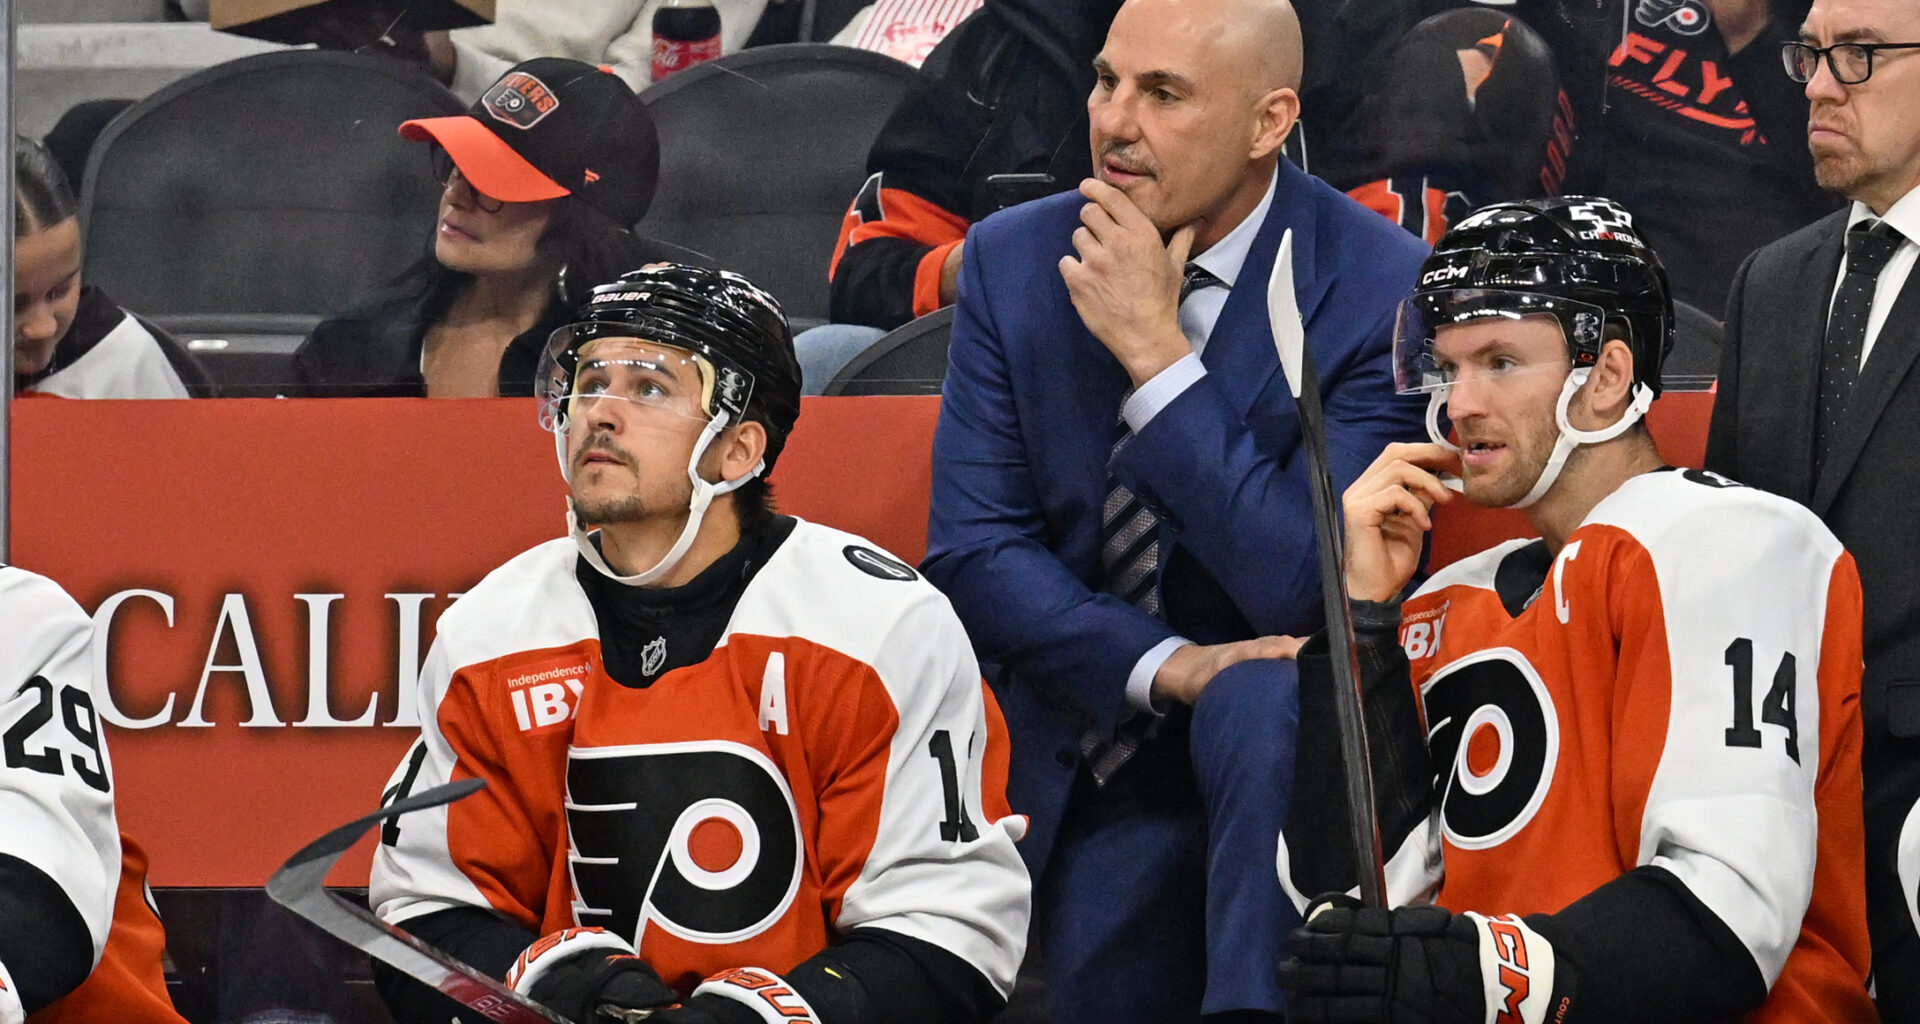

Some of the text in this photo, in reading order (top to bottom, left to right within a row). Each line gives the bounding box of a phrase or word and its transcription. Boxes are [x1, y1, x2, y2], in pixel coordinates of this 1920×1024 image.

[591, 291, 652, 304] BAUER
[1422, 266, 1469, 285] CCM
[1552, 539, 1582, 624] C
[92, 588, 466, 728] CALI
[507, 665, 584, 688] Independence
[758, 651, 789, 735] A
[2, 674, 110, 793] 29
[1724, 637, 1801, 768] 14
